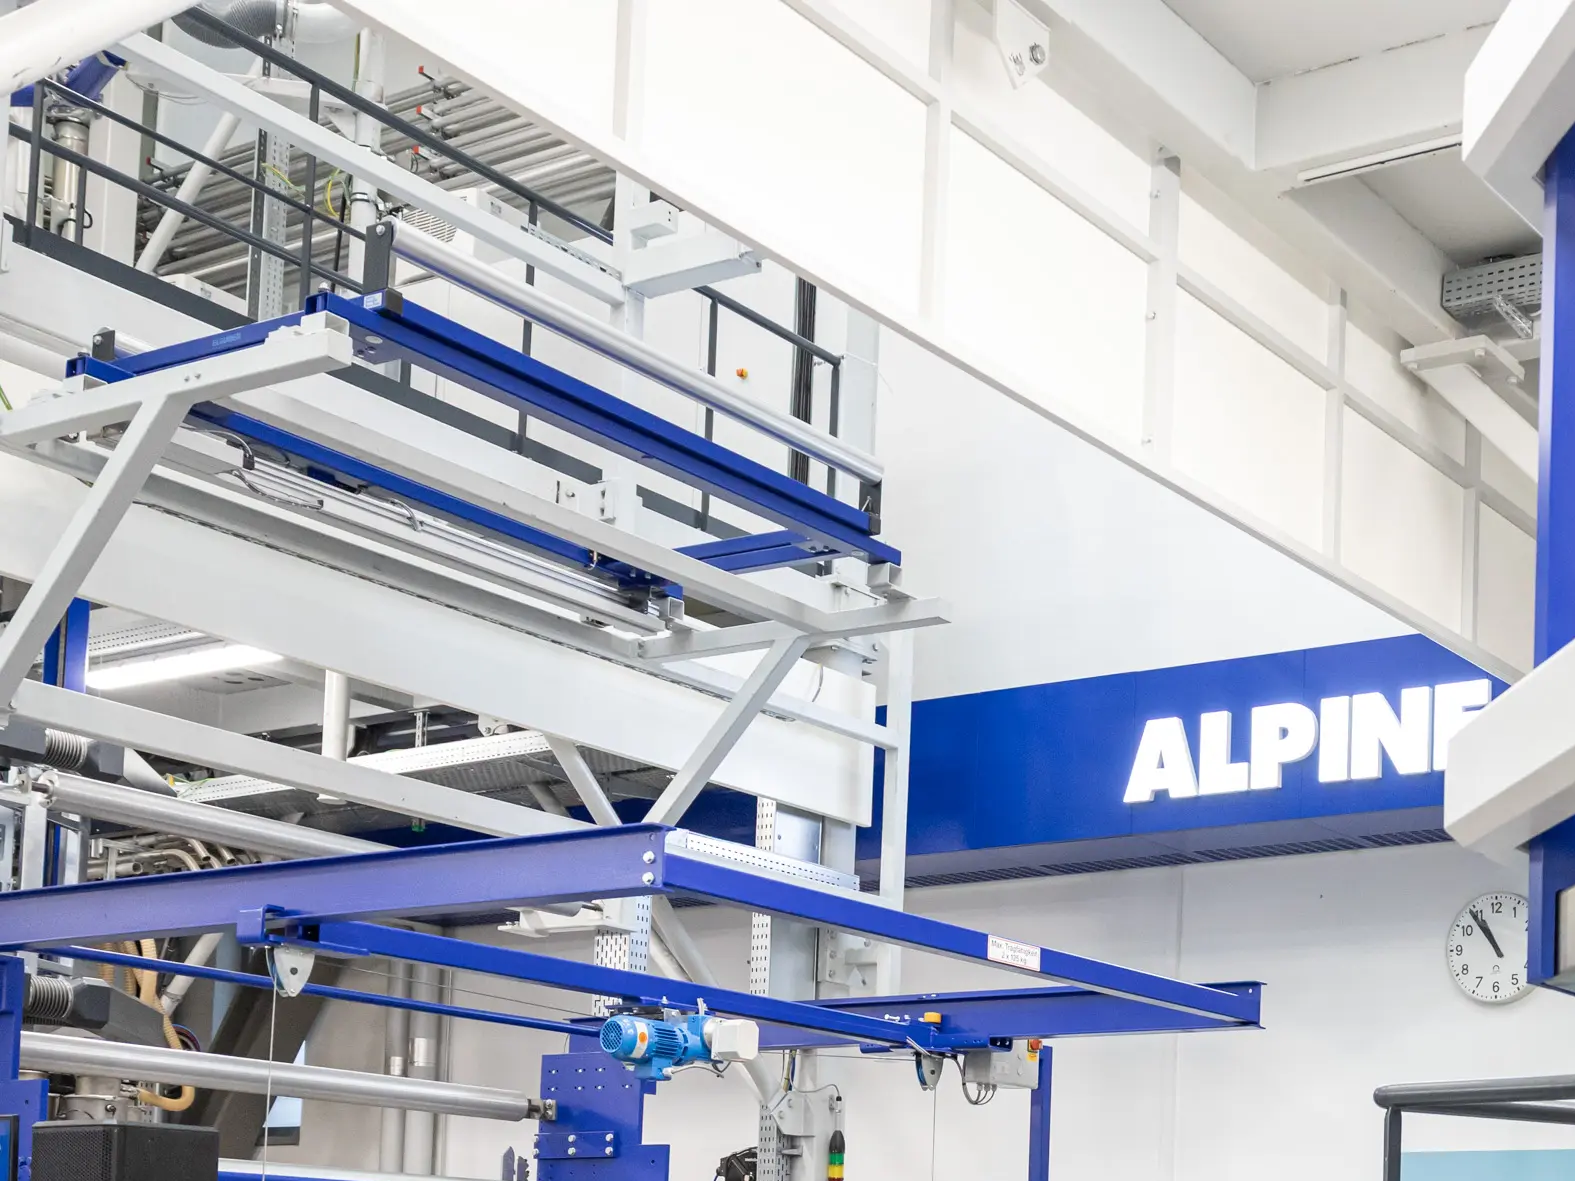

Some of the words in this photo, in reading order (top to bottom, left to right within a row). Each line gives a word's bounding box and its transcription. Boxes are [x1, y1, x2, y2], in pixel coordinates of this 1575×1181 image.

[1123, 679, 1493, 803] ALPINE
[1491, 902, 1503, 914] 12
[1513, 906, 1517, 918] 1
[1461, 925, 1474, 937] 10
[1455, 944, 1463, 956] 9
[1461, 963, 1469, 975] 8
[1475, 976, 1483, 988] 7
[1511, 973, 1519, 985] 5
[1492, 981, 1500, 993] 6
